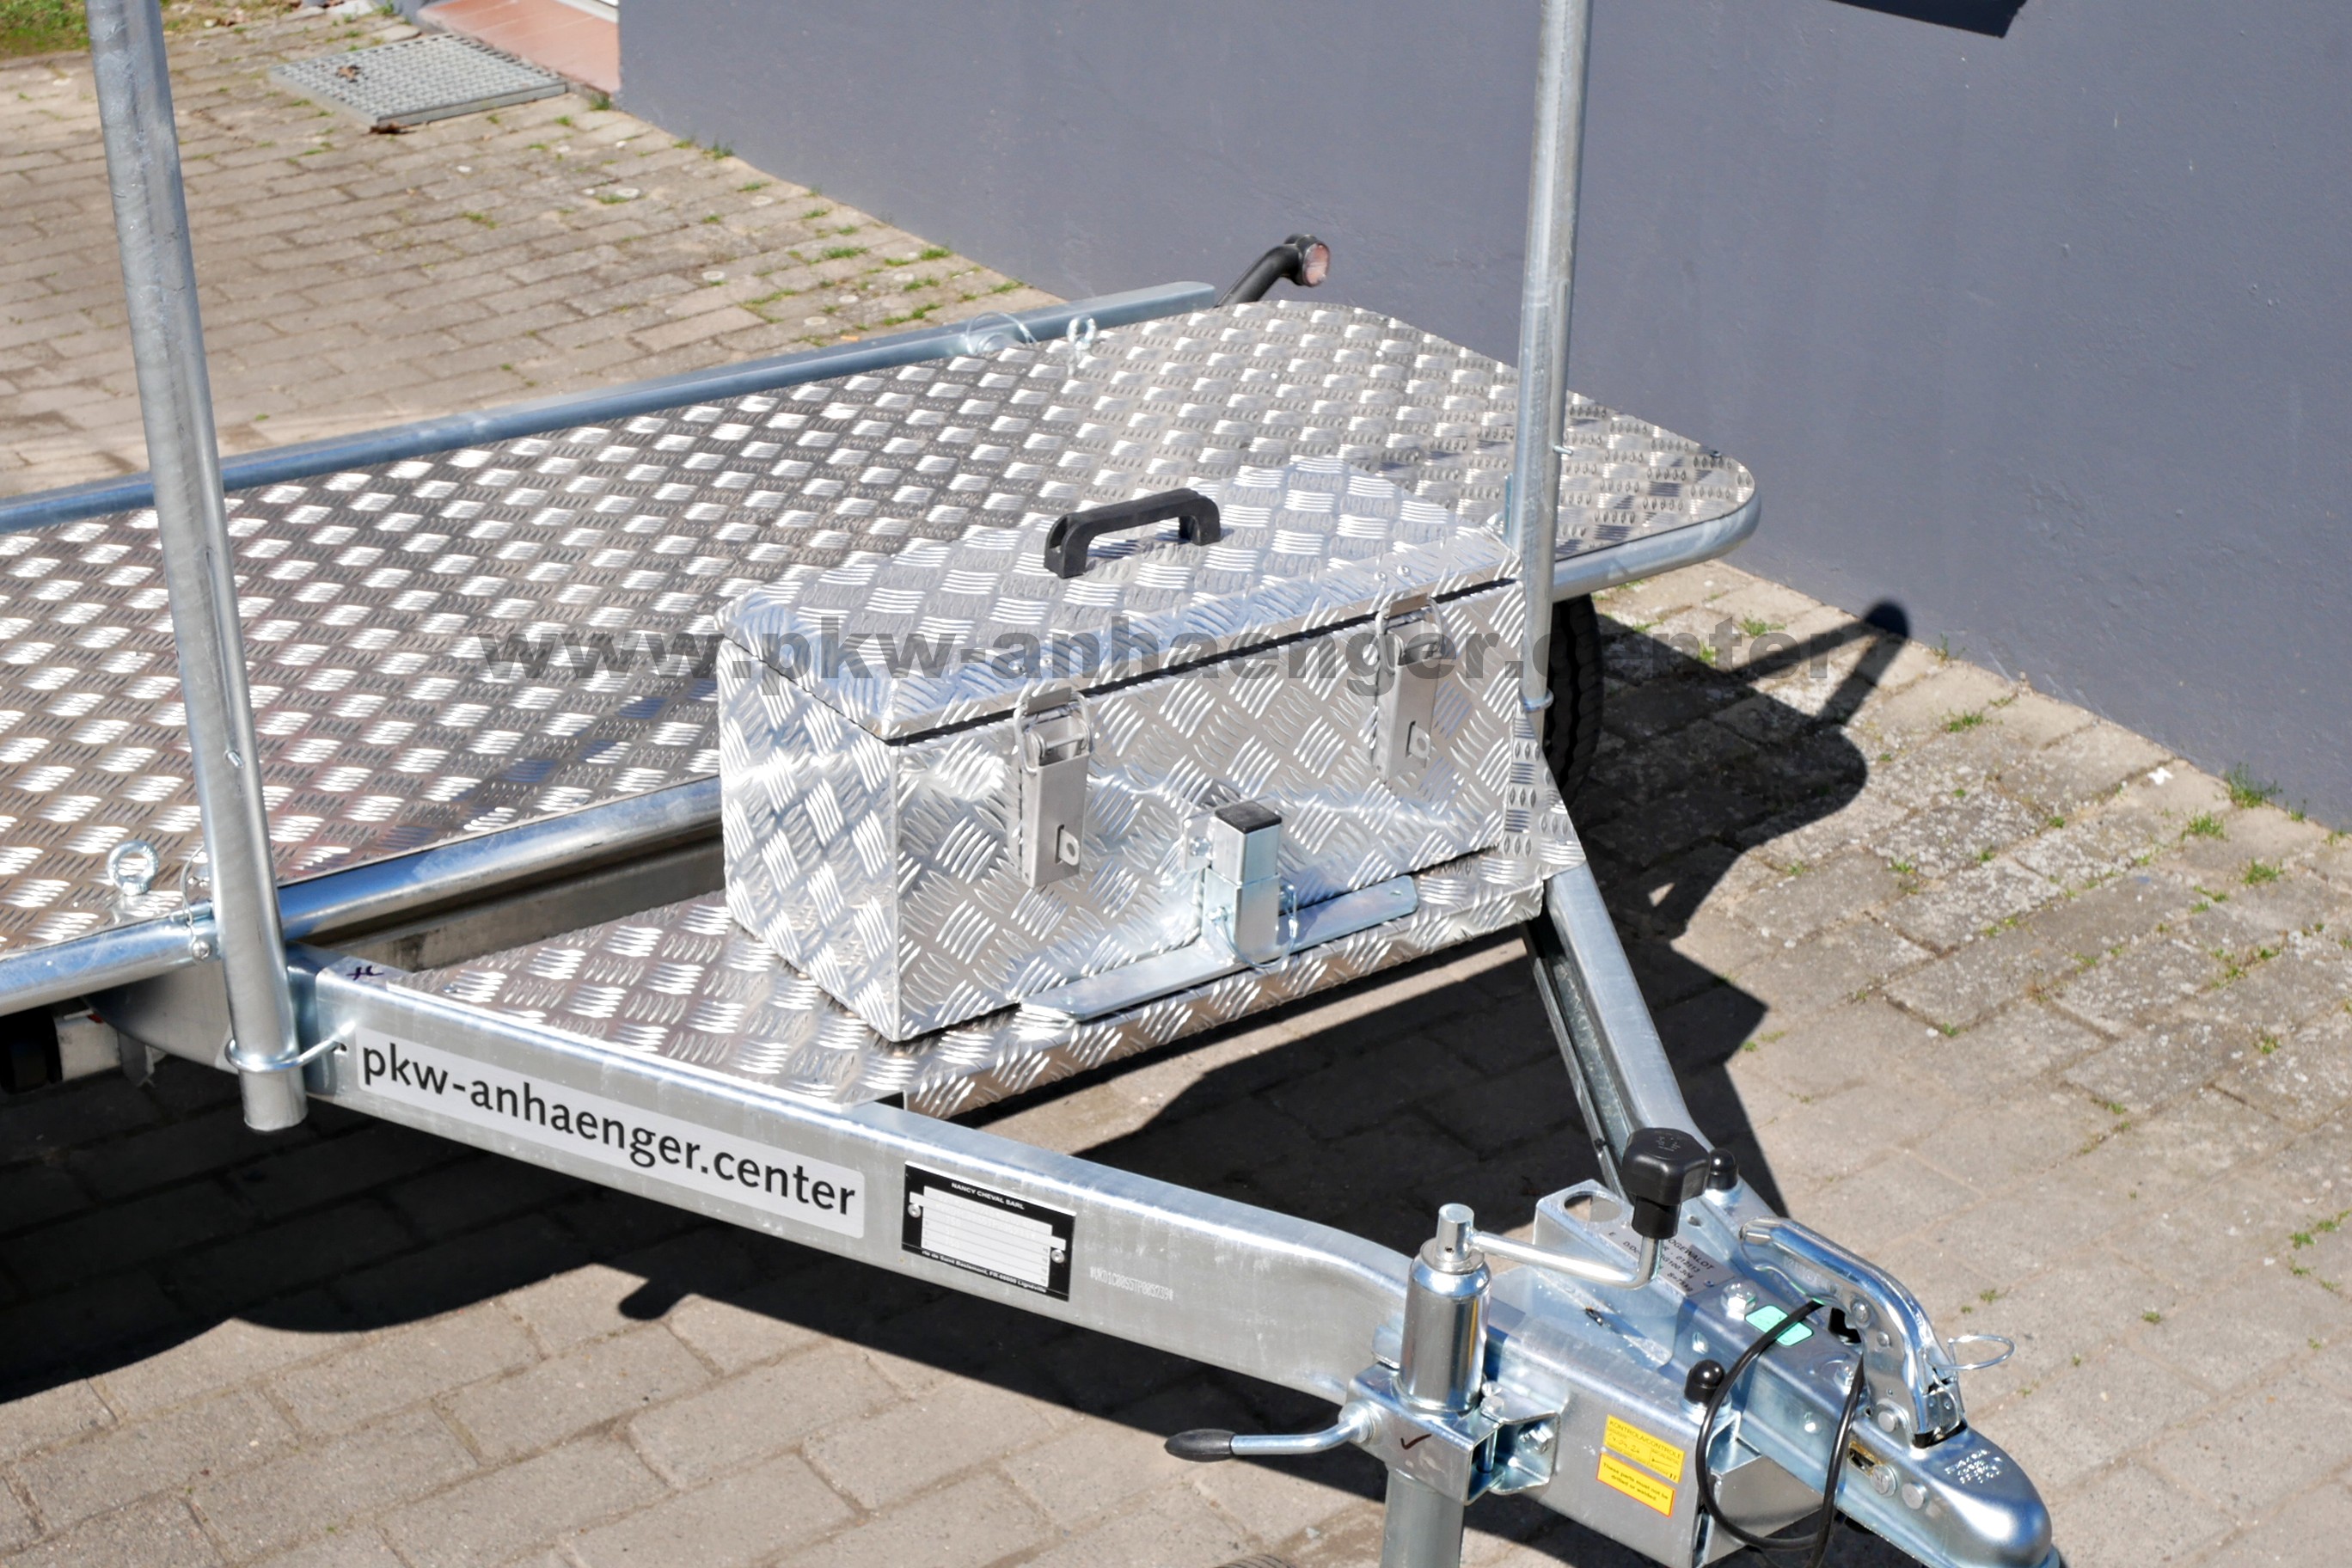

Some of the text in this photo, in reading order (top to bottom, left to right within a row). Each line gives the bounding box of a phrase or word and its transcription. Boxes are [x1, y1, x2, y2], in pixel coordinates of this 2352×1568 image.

[362, 1042, 855, 1216] pkw-anhaenger.center
[951, 1182, 1026, 1210] NANCY CHEVAL SARL
[1636, 1479, 1651, 1490] must
